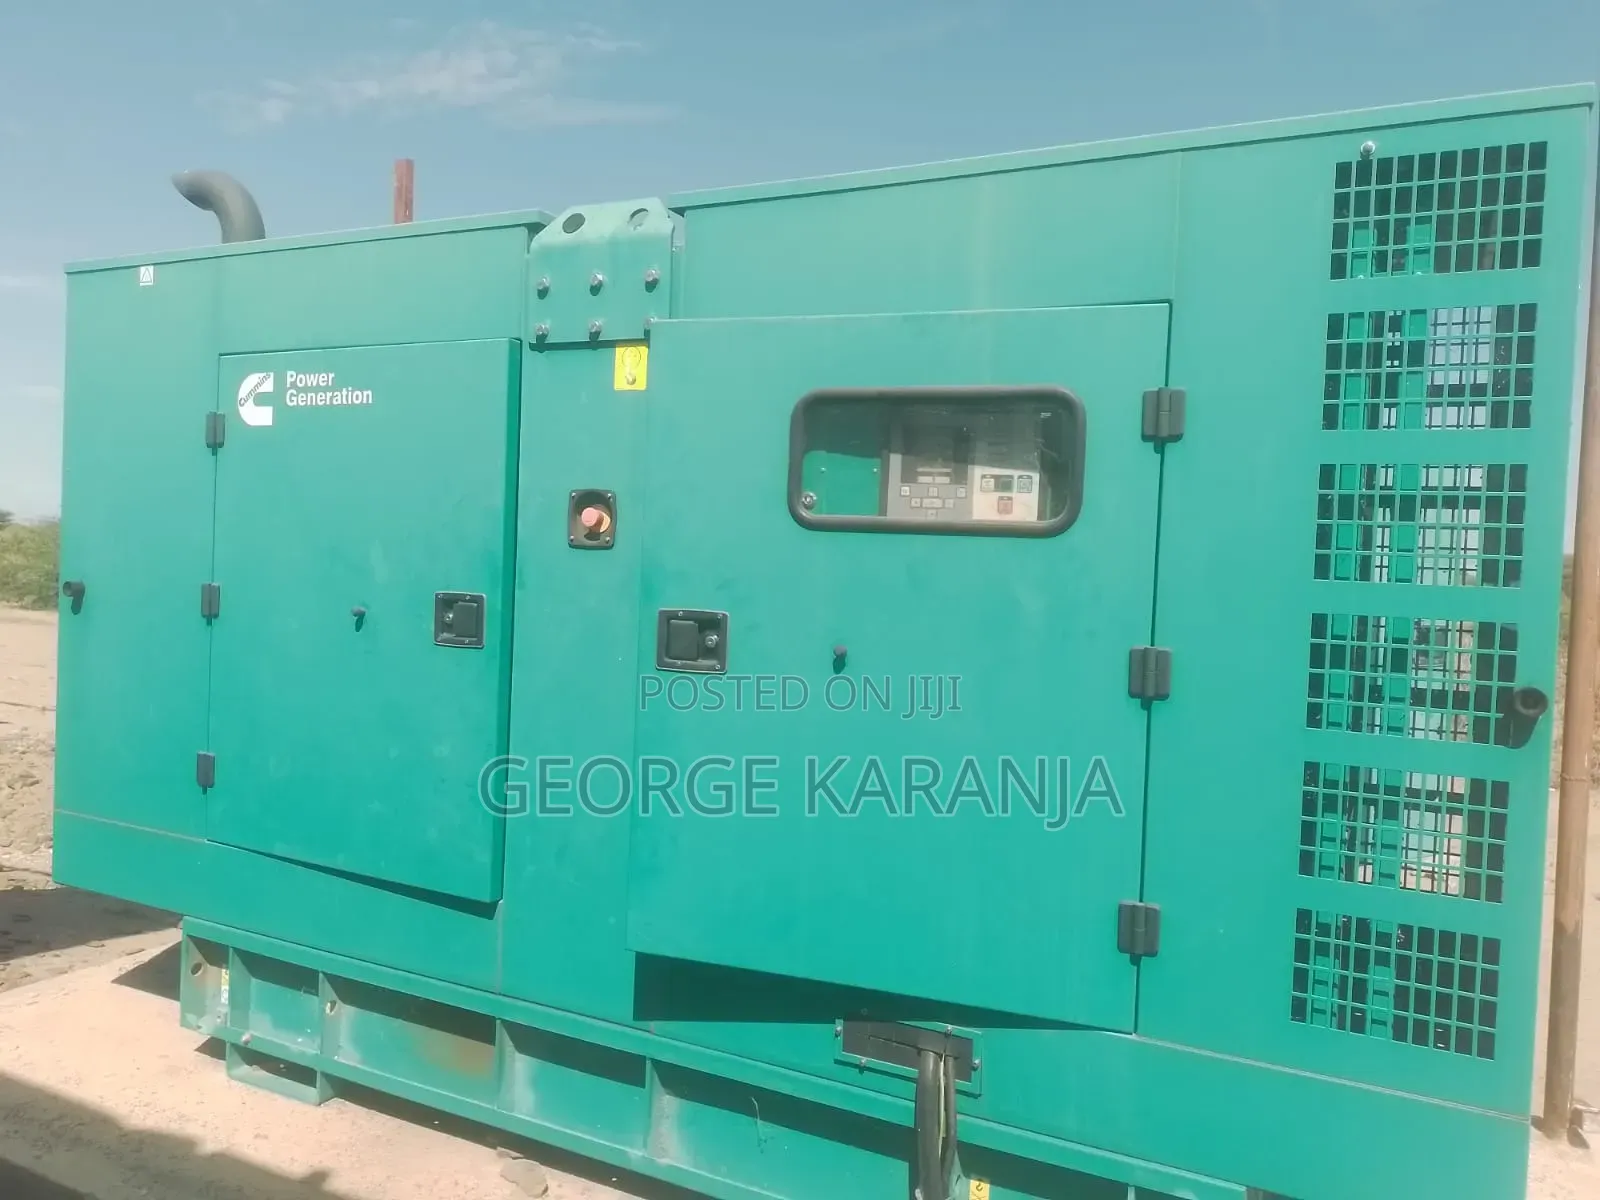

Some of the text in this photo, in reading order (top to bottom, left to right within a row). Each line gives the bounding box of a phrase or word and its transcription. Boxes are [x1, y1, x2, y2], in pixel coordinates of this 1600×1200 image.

[286, 371, 335, 388] Power
[238, 372, 272, 408] Cummins
[286, 387, 373, 407] Generation
